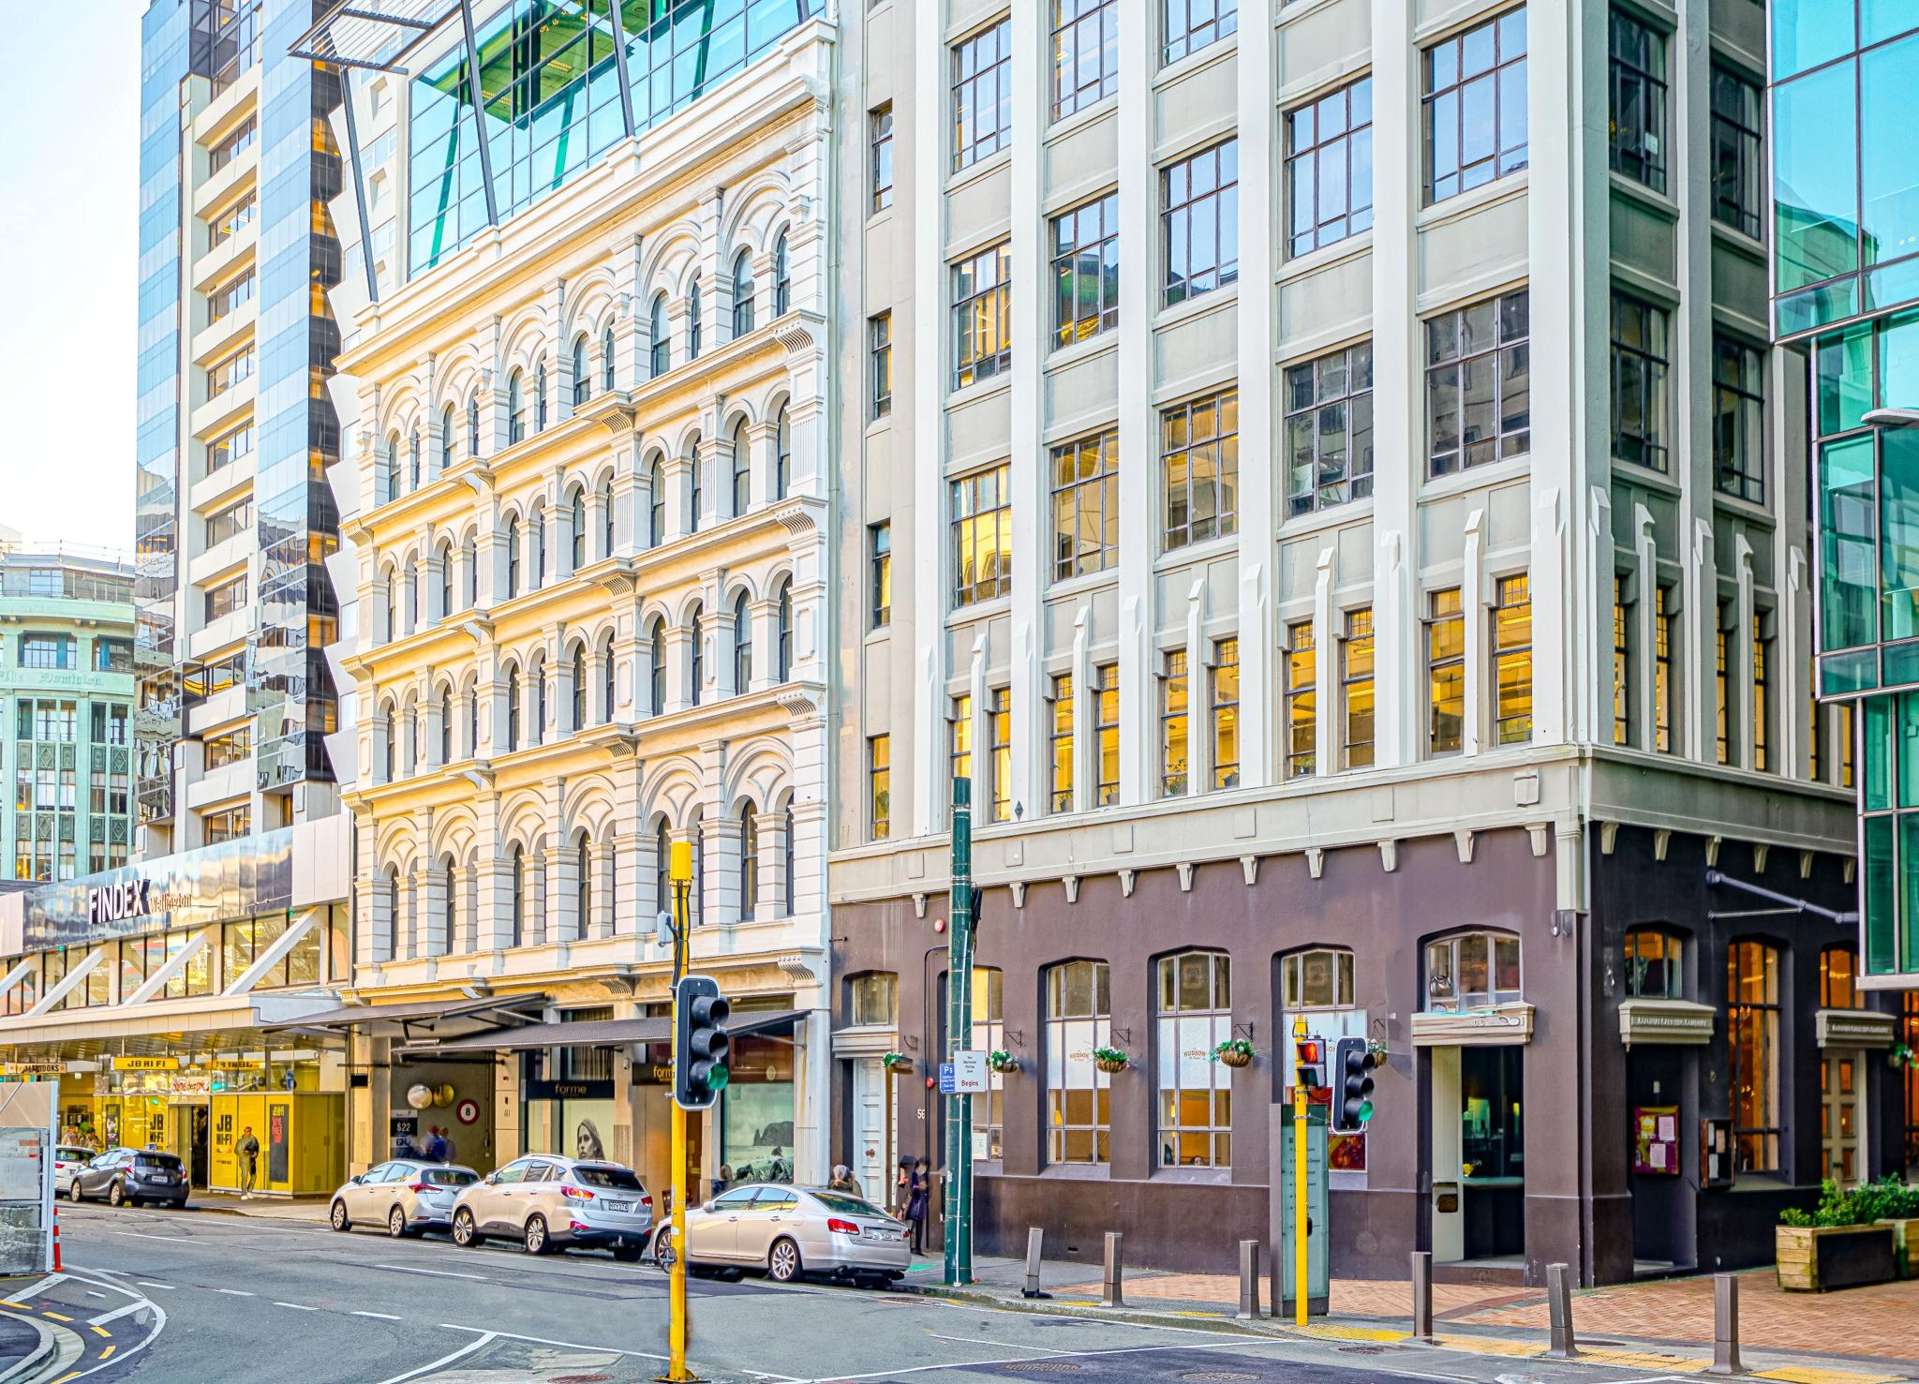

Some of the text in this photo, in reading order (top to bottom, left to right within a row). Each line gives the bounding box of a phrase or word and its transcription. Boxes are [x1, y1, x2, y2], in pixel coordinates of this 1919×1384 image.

[88, 879, 150, 925] FINDEX
[554, 1083, 587, 1095] forme
[150, 1114, 164, 1130] JB
[216, 1115, 232, 1132] JB
